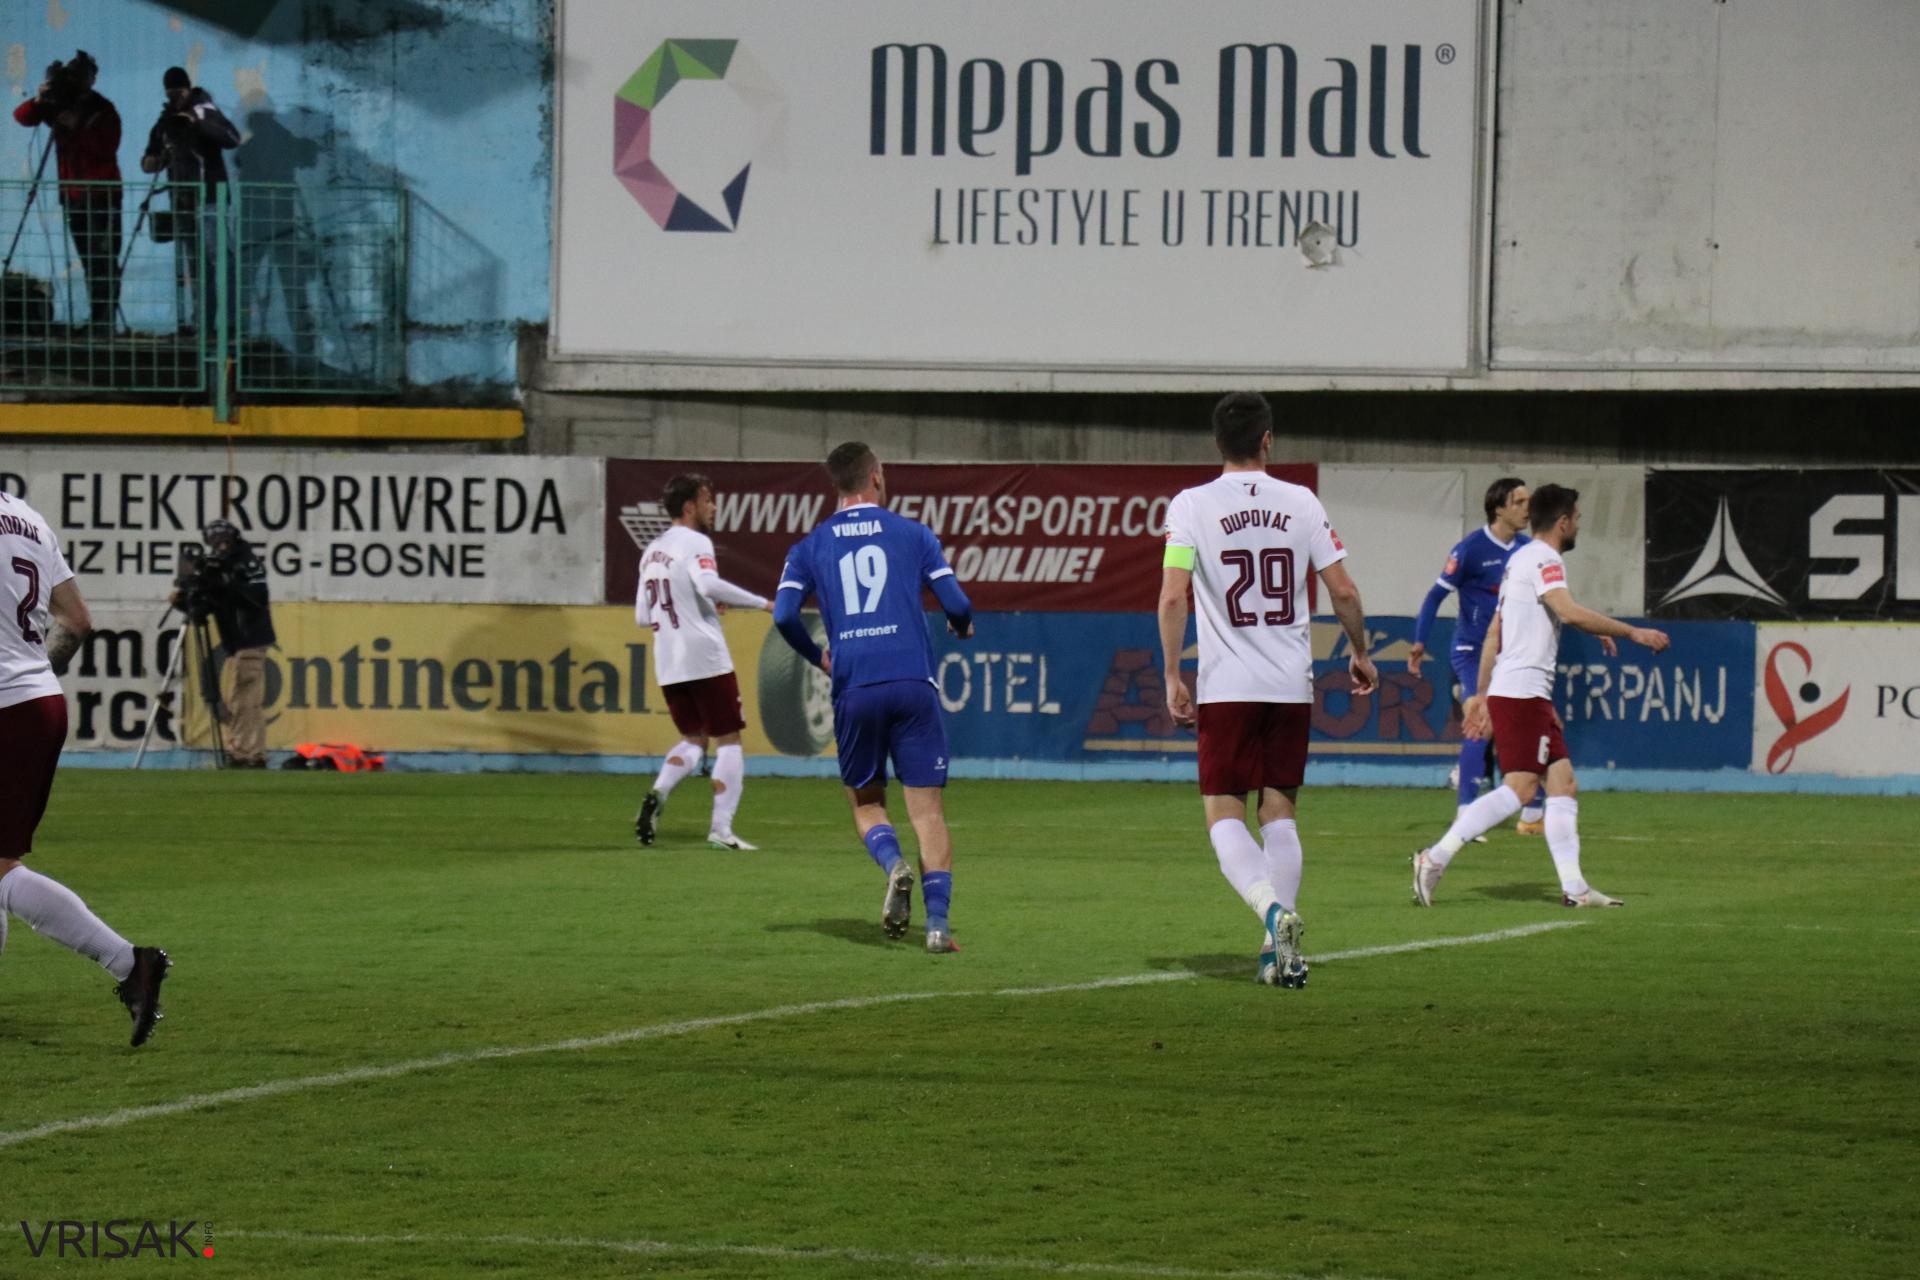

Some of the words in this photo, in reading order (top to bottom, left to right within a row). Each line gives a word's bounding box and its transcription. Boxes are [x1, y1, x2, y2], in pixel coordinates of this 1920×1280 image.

[869, 43, 1181, 176] Mepas
[1217, 43, 1432, 159] Mall
[933, 188, 1141, 247] LIFESTYLE
[1162, 188, 1185, 247] U
[1201, 189, 1359, 248] TRENDU
[61, 473, 567, 535] ELEKTROPRIVREDA
[832, 520, 883, 537] VUKOJA
[1219, 509, 1292, 536] DUPOVAC
[839, 545, 888, 615] 19
[952, 547, 1105, 583] ONLINE!
[1220, 547, 1295, 627] 29
[11, 556, 42, 645] 2
[937, 652, 1061, 714] OTEL
[1557, 663, 1727, 724] TRPANJ
[1537, 735, 1550, 765] 6
